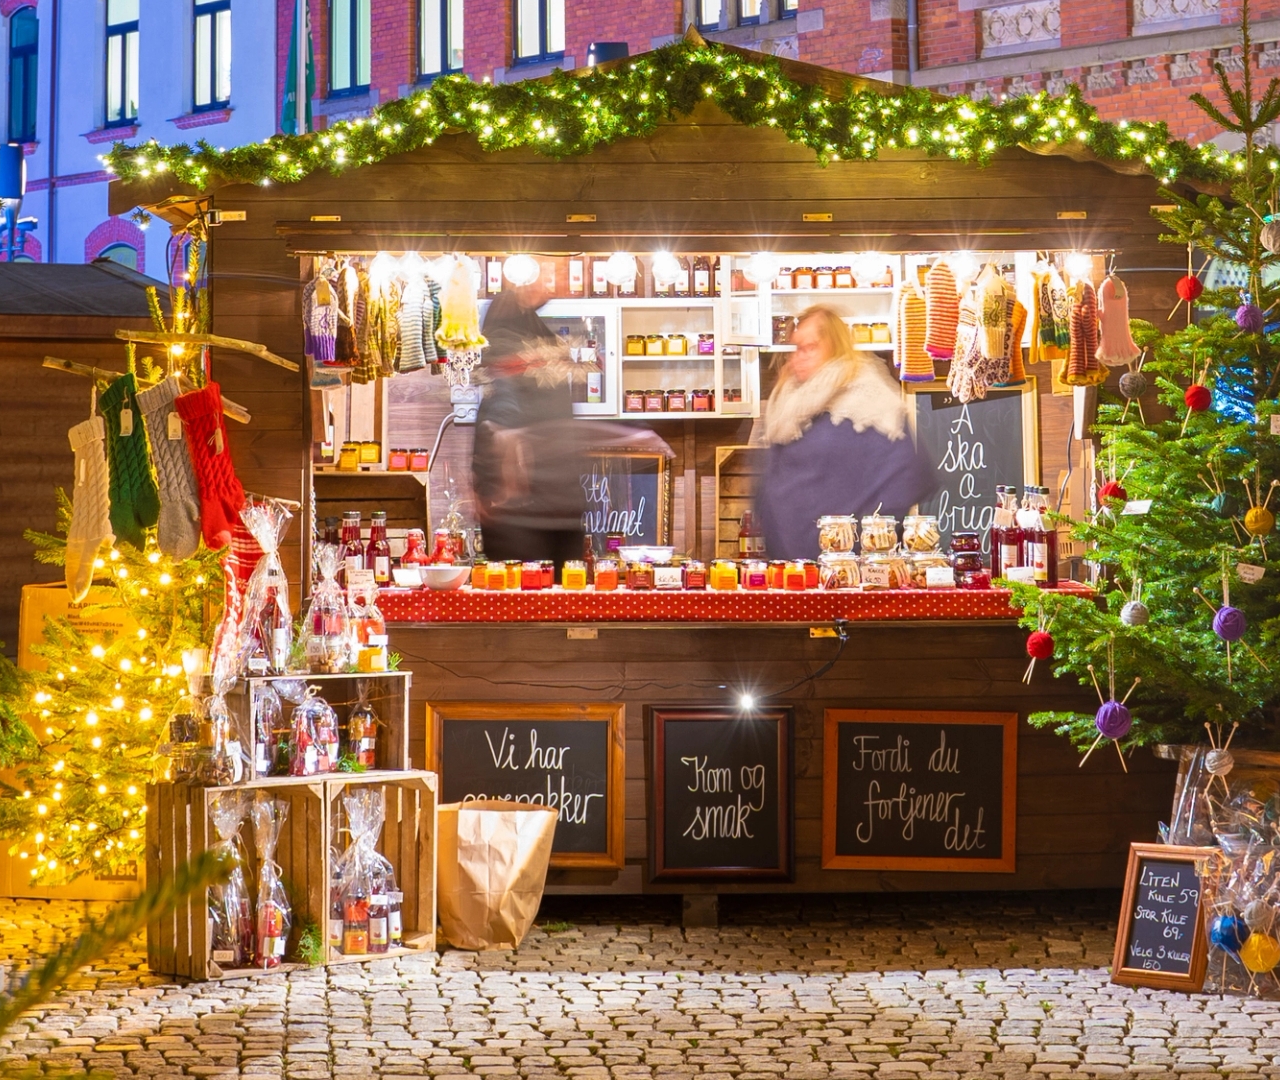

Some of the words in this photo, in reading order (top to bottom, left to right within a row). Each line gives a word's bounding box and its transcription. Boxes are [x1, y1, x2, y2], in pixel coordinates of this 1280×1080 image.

[938, 434, 987, 472] ska
[484, 727, 519, 770] Vi
[525, 728, 570, 770] har
[853, 734, 912, 772] Fordi
[928, 729, 960, 774] du
[681, 755, 733, 793] Kom
[740, 764, 765, 811] og
[683, 794, 754, 840] smak
[856, 780, 965, 843] fortjener
[944, 806, 986, 851] det
[1134, 905, 1159, 922] STOR
[1161, 908, 1188, 925] KULE
[1143, 959, 1161, 971] 150
[1156, 945, 1166, 958] 3
